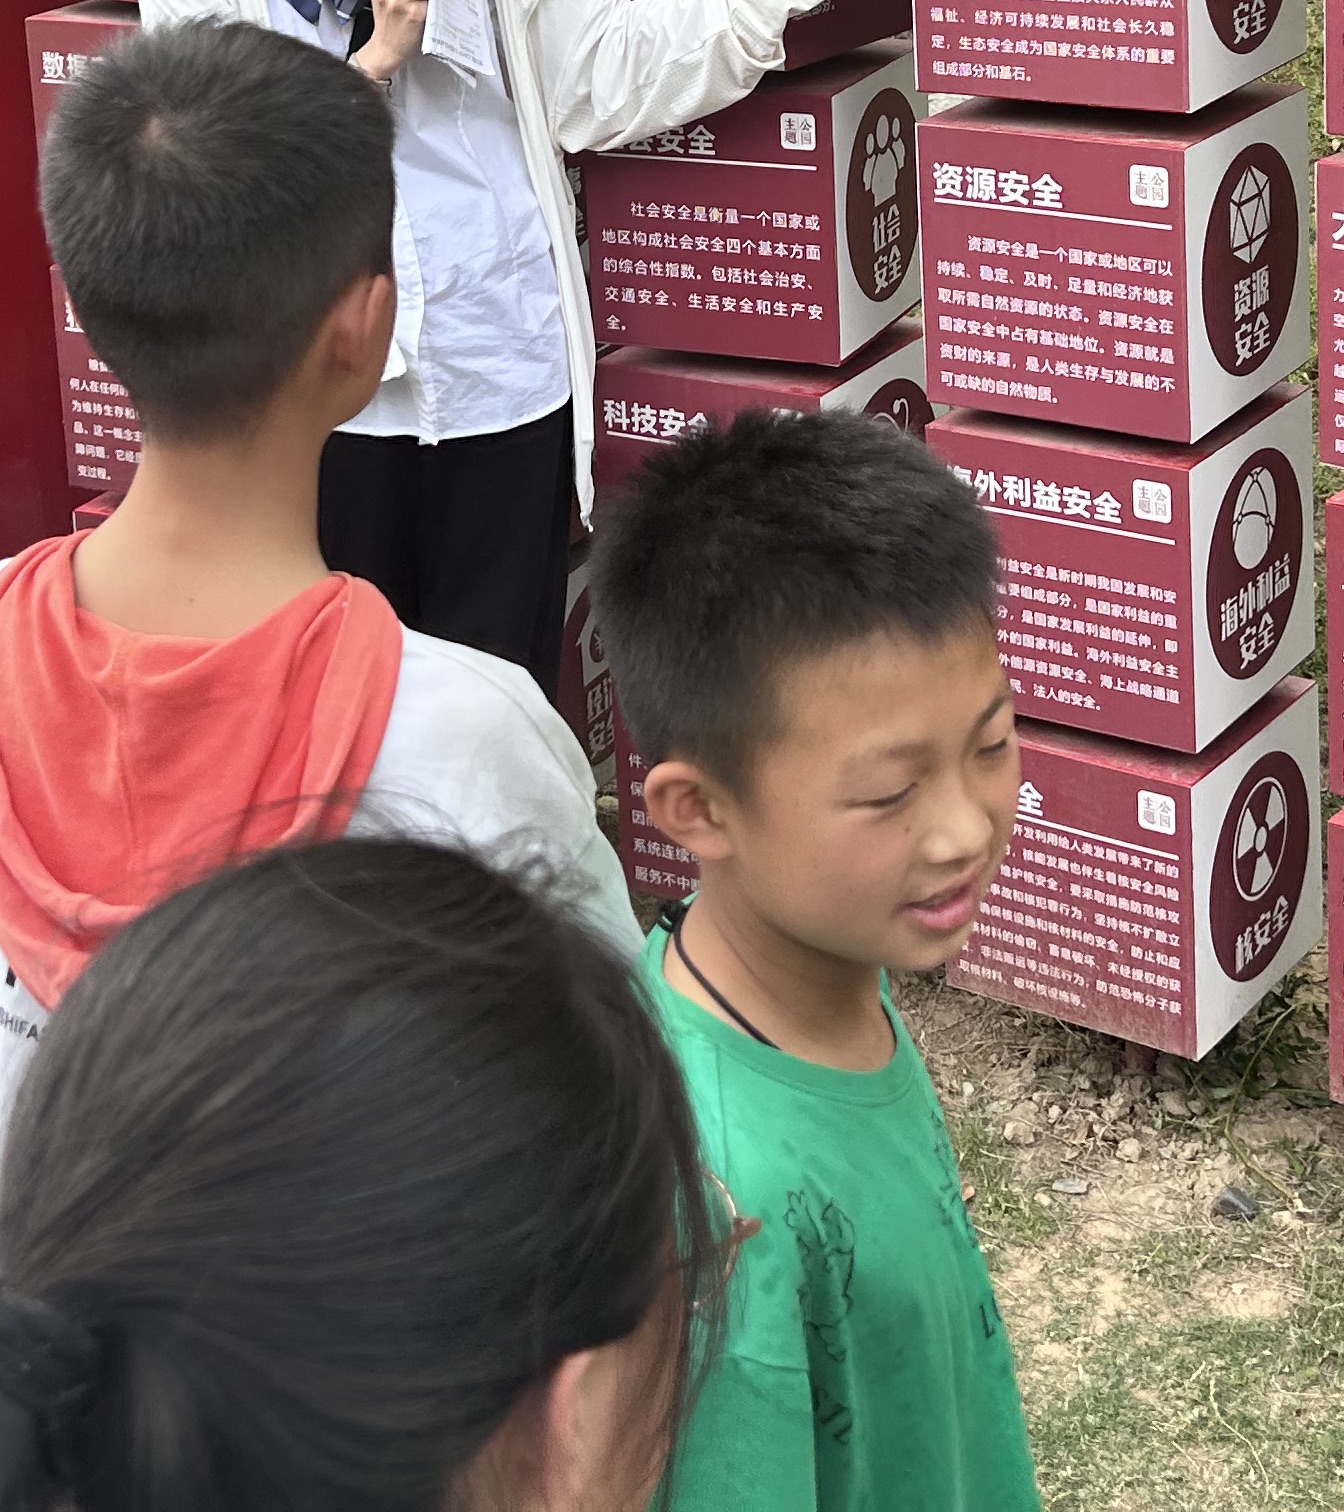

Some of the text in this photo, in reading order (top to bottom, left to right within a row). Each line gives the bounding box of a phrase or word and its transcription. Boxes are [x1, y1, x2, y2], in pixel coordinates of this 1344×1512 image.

[606, 124, 716, 156] 会安全
[933, 162, 1063, 209] 资源安全
[630, 201, 820, 232] 社会安全是衡量一个国家或
[602, 229, 822, 262] 地区构成社会安全四个基本方面
[967, 236, 1173, 276] 资源安全是一个国家或地区可以
[605, 286, 824, 320] 交通安全、生活安全和生产安
[72, 400, 140, 420] 为维持生存和
